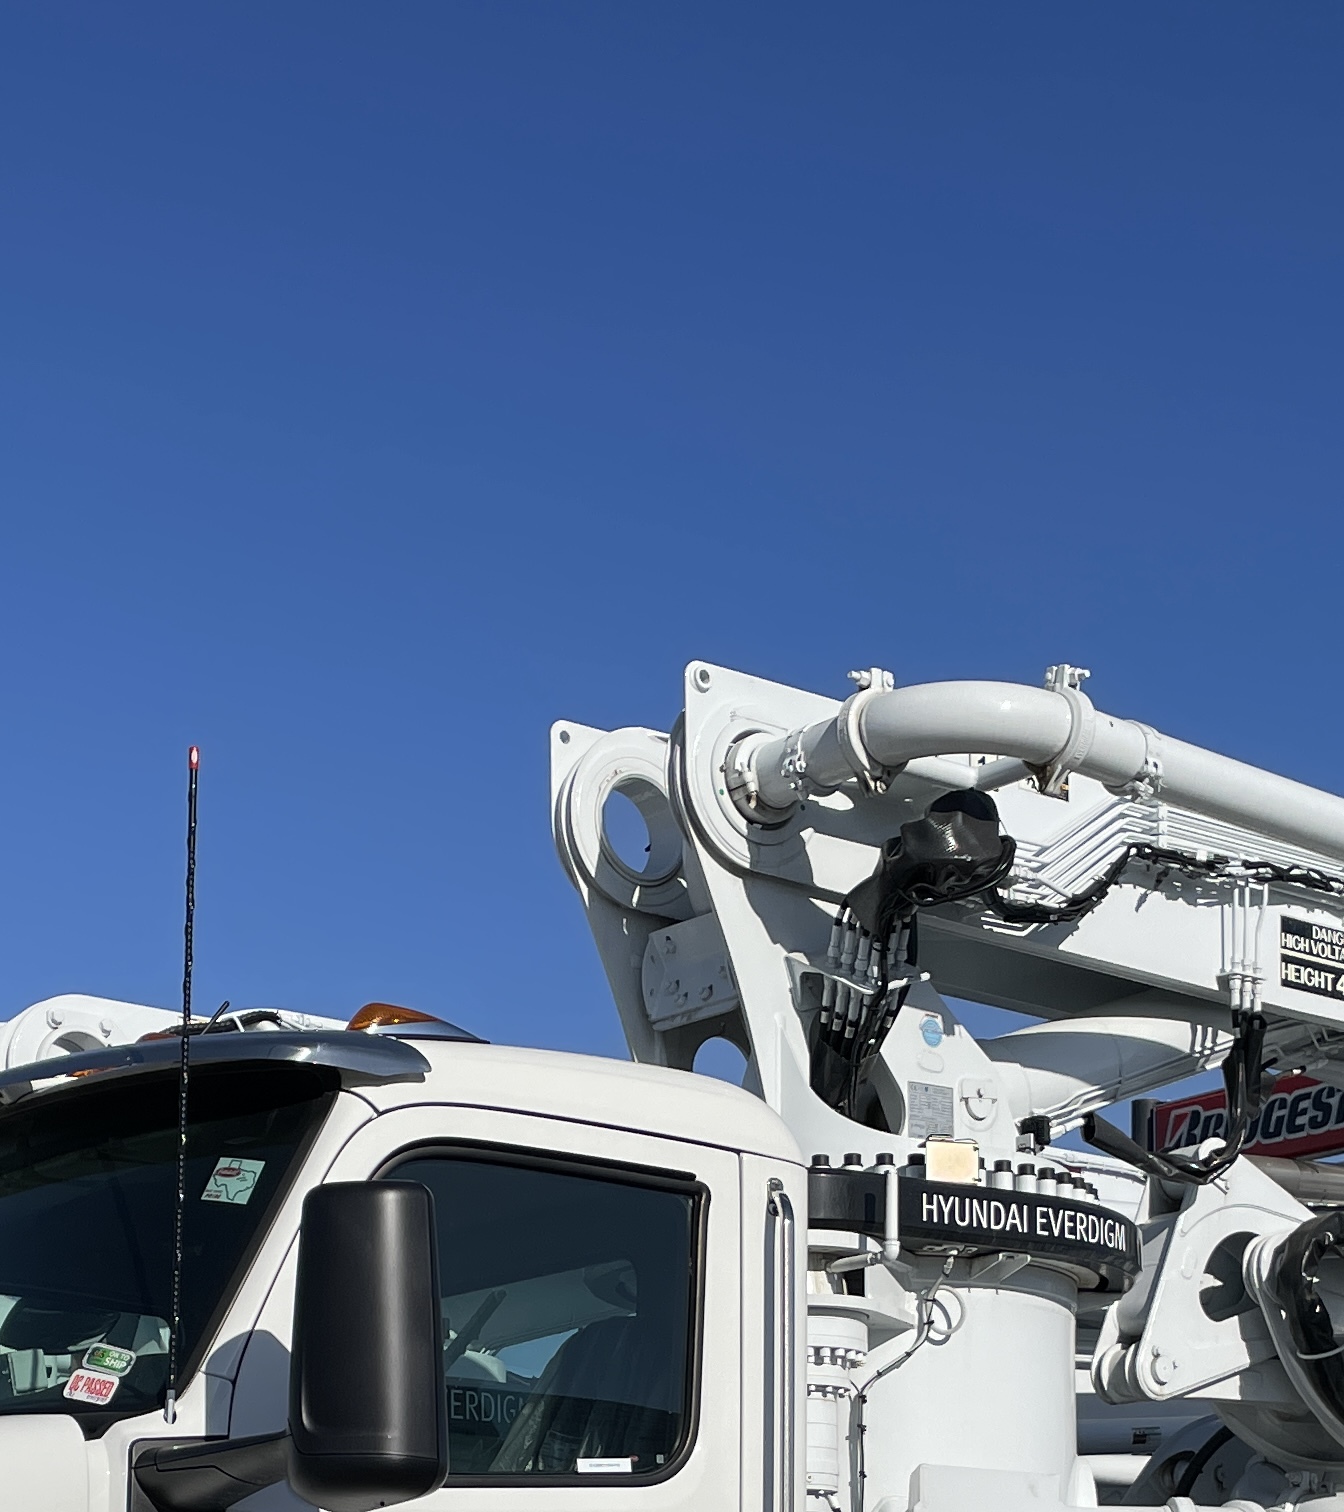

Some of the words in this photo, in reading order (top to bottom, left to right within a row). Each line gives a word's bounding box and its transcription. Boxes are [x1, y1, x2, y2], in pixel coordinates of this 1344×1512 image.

[1281, 932, 1310, 953] HIGH
[1281, 961, 1336, 992] HEIGHT
[922, 1192, 1029, 1234] HYUNDAI
[1035, 1206, 1127, 1251] EVERDIGM
[103, 1357, 127, 1369] SHIP
[80, 1376, 115, 1398] PASSED
